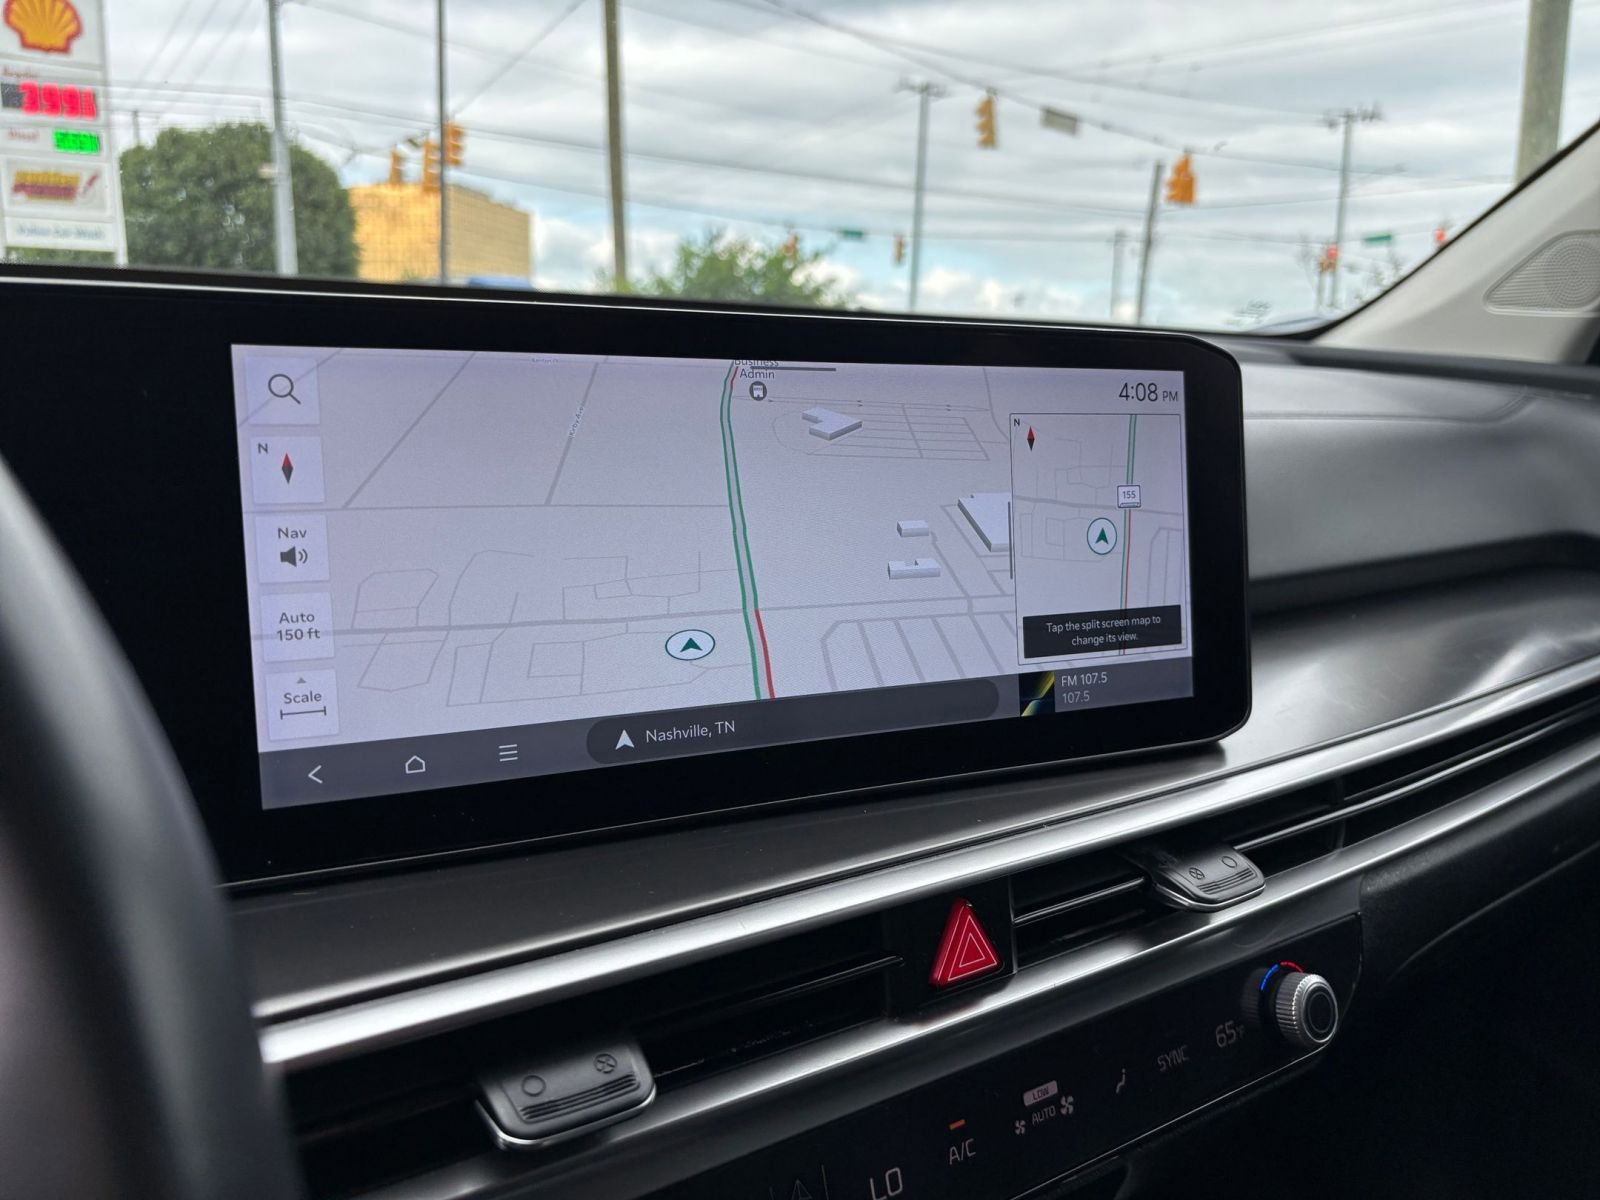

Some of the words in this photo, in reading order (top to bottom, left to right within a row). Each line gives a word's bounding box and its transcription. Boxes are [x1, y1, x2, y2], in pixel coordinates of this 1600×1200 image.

[739, 368, 775, 379] Admin
[1118, 382, 1159, 402] 4:08
[1162, 390, 1179, 402] PM
[1013, 418, 1021, 427] N
[257, 442, 269, 454] N
[1122, 490, 1136, 500] 155
[277, 527, 307, 540] Nav
[279, 611, 315, 624] Auto
[1046, 622, 1064, 634] Tap
[1065, 621, 1080, 631] the
[1081, 617, 1100, 631] split
[1101, 618, 1130, 629] screen
[1131, 617, 1151, 627] map
[1151, 614, 1161, 625] to
[276, 628, 304, 641] 150
[306, 626, 321, 640] ft
[1071, 635, 1104, 647] change
[1105, 634, 1117, 643] its
[1117, 631, 1139, 642] view.
[1061, 675, 1078, 687] FM
[1080, 671, 1108, 684] 107.5
[283, 690, 323, 705] Scale
[1062, 690, 1090, 704] 107.5
[645, 725, 713, 743] Nashville,
[714, 720, 736, 735] TN
[1157, 1044, 1190, 1072] SYNC
[1032, 1086, 1049, 1101] LOW
[1031, 1105, 1057, 1126] AUTO
[949, 1137, 977, 1166] A/C
[869, 1166, 904, 1200] LO
